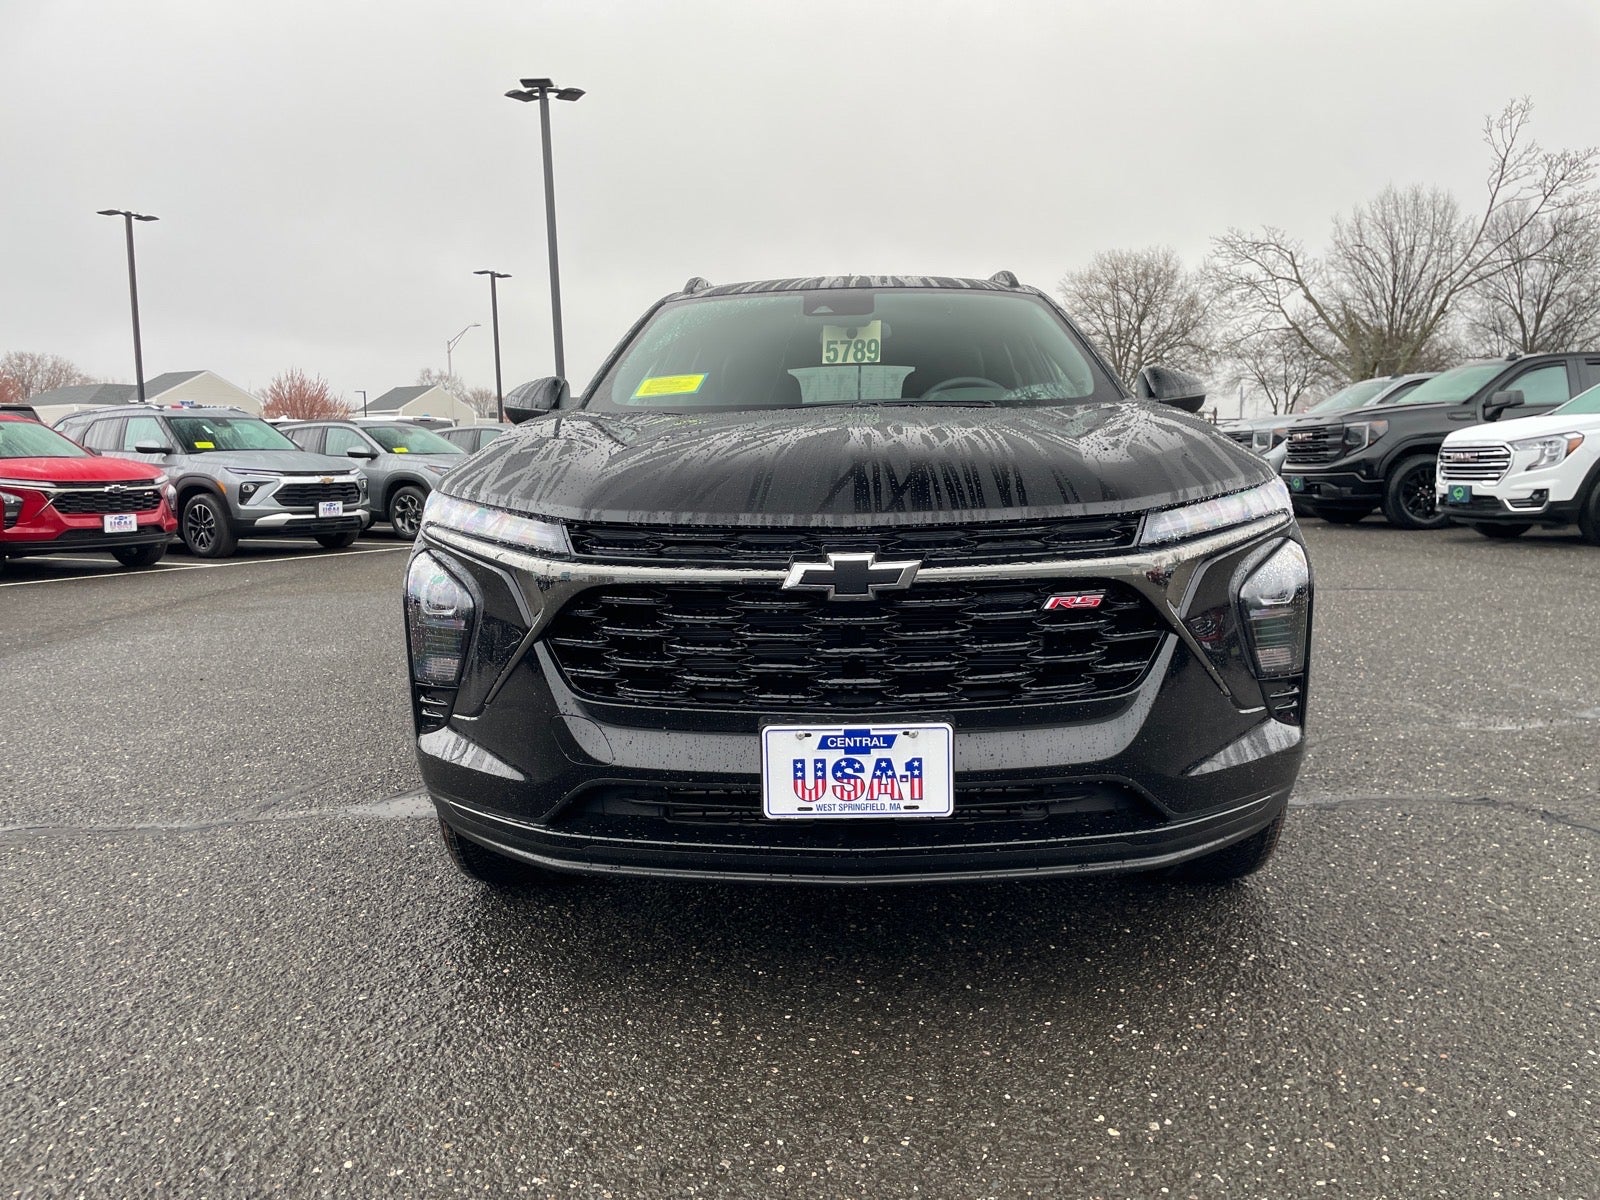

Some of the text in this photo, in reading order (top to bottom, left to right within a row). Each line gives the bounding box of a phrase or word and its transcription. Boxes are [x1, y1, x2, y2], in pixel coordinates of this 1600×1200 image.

[825, 339, 880, 362] 5789
[1043, 594, 1104, 609] RS
[827, 736, 888, 748] CENTRAL
[815, 802, 902, 811] WEST SPRINGFIELD, MA
